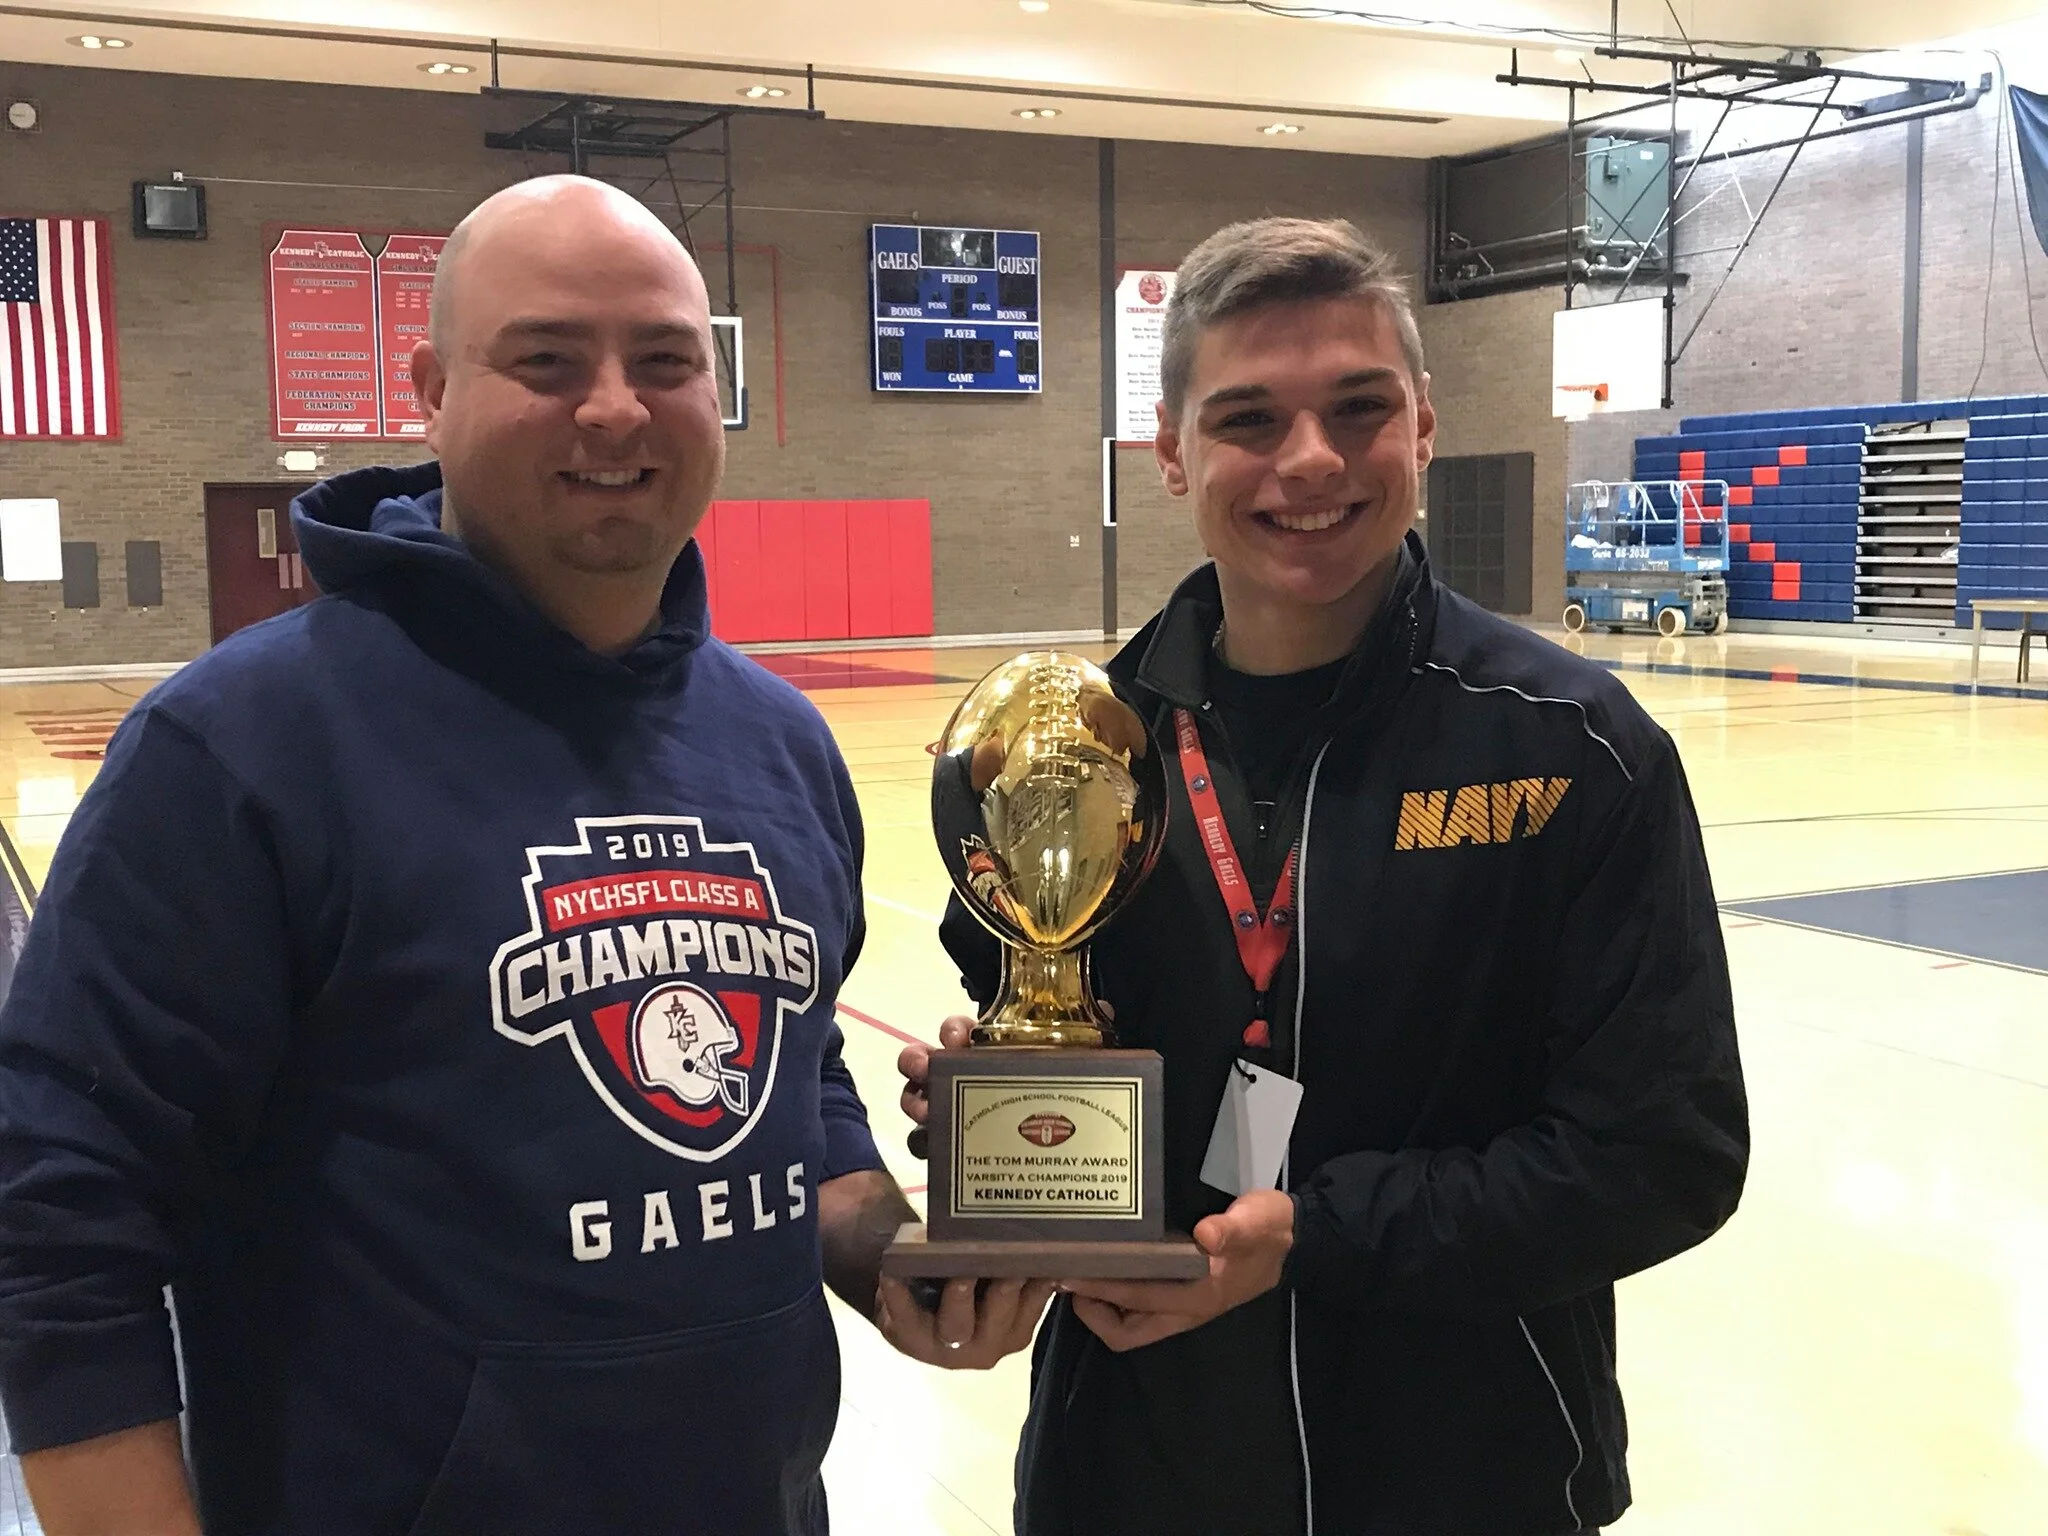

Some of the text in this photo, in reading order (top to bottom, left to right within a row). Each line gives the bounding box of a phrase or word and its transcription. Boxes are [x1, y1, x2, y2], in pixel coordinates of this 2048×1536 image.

[279, 247, 365, 259] KENNEDY CATHOLIC
[386, 252, 420, 261] KENNEDY
[877, 250, 919, 271] GAELS
[998, 255, 1037, 275] GUEST
[941, 273, 978, 284] PERIOD
[928, 301, 948, 310] POSS
[972, 303, 991, 311] POSS
[890, 306, 923, 318] BONUS
[996, 310, 1028, 321] BONUS
[288, 322, 366, 332] SECTION CHAMPIONS
[393, 324, 427, 333] SECTION
[878, 326, 905, 337] FOULS
[944, 328, 977, 339] PLAYER
[1013, 330, 1039, 340] FOULS
[285, 350, 370, 360] REGIONAL CHAMPIONS
[288, 370, 370, 381] STATE CHAMPIONS
[882, 371, 902, 382] WON
[948, 373, 975, 383] GAME
[1018, 374, 1037, 384] WON
[286, 390, 373, 401] FEDERATION STATE
[303, 401, 356, 411] CHAMPIONS
[295, 423, 368, 433] KENNEDY PRIDE
[1394, 776, 1573, 850] NAVY
[605, 833, 691, 861] 2019
[552, 879, 760, 921] NYCHSFL CLASS A
[507, 919, 812, 1019] CHAMPIONS
[964, 1093, 1129, 1133] CATHOLIC HIGH SCHOOL FOOTBALL LEAGUE
[966, 1155, 1128, 1167] THE TOM MURRAY AWARD
[966, 1173, 1128, 1184] VARSITY A CHAMPIONS 2019
[974, 1189, 1119, 1201] KENNEDY CATHOLIC
[569, 1162, 806, 1262] GAELS
